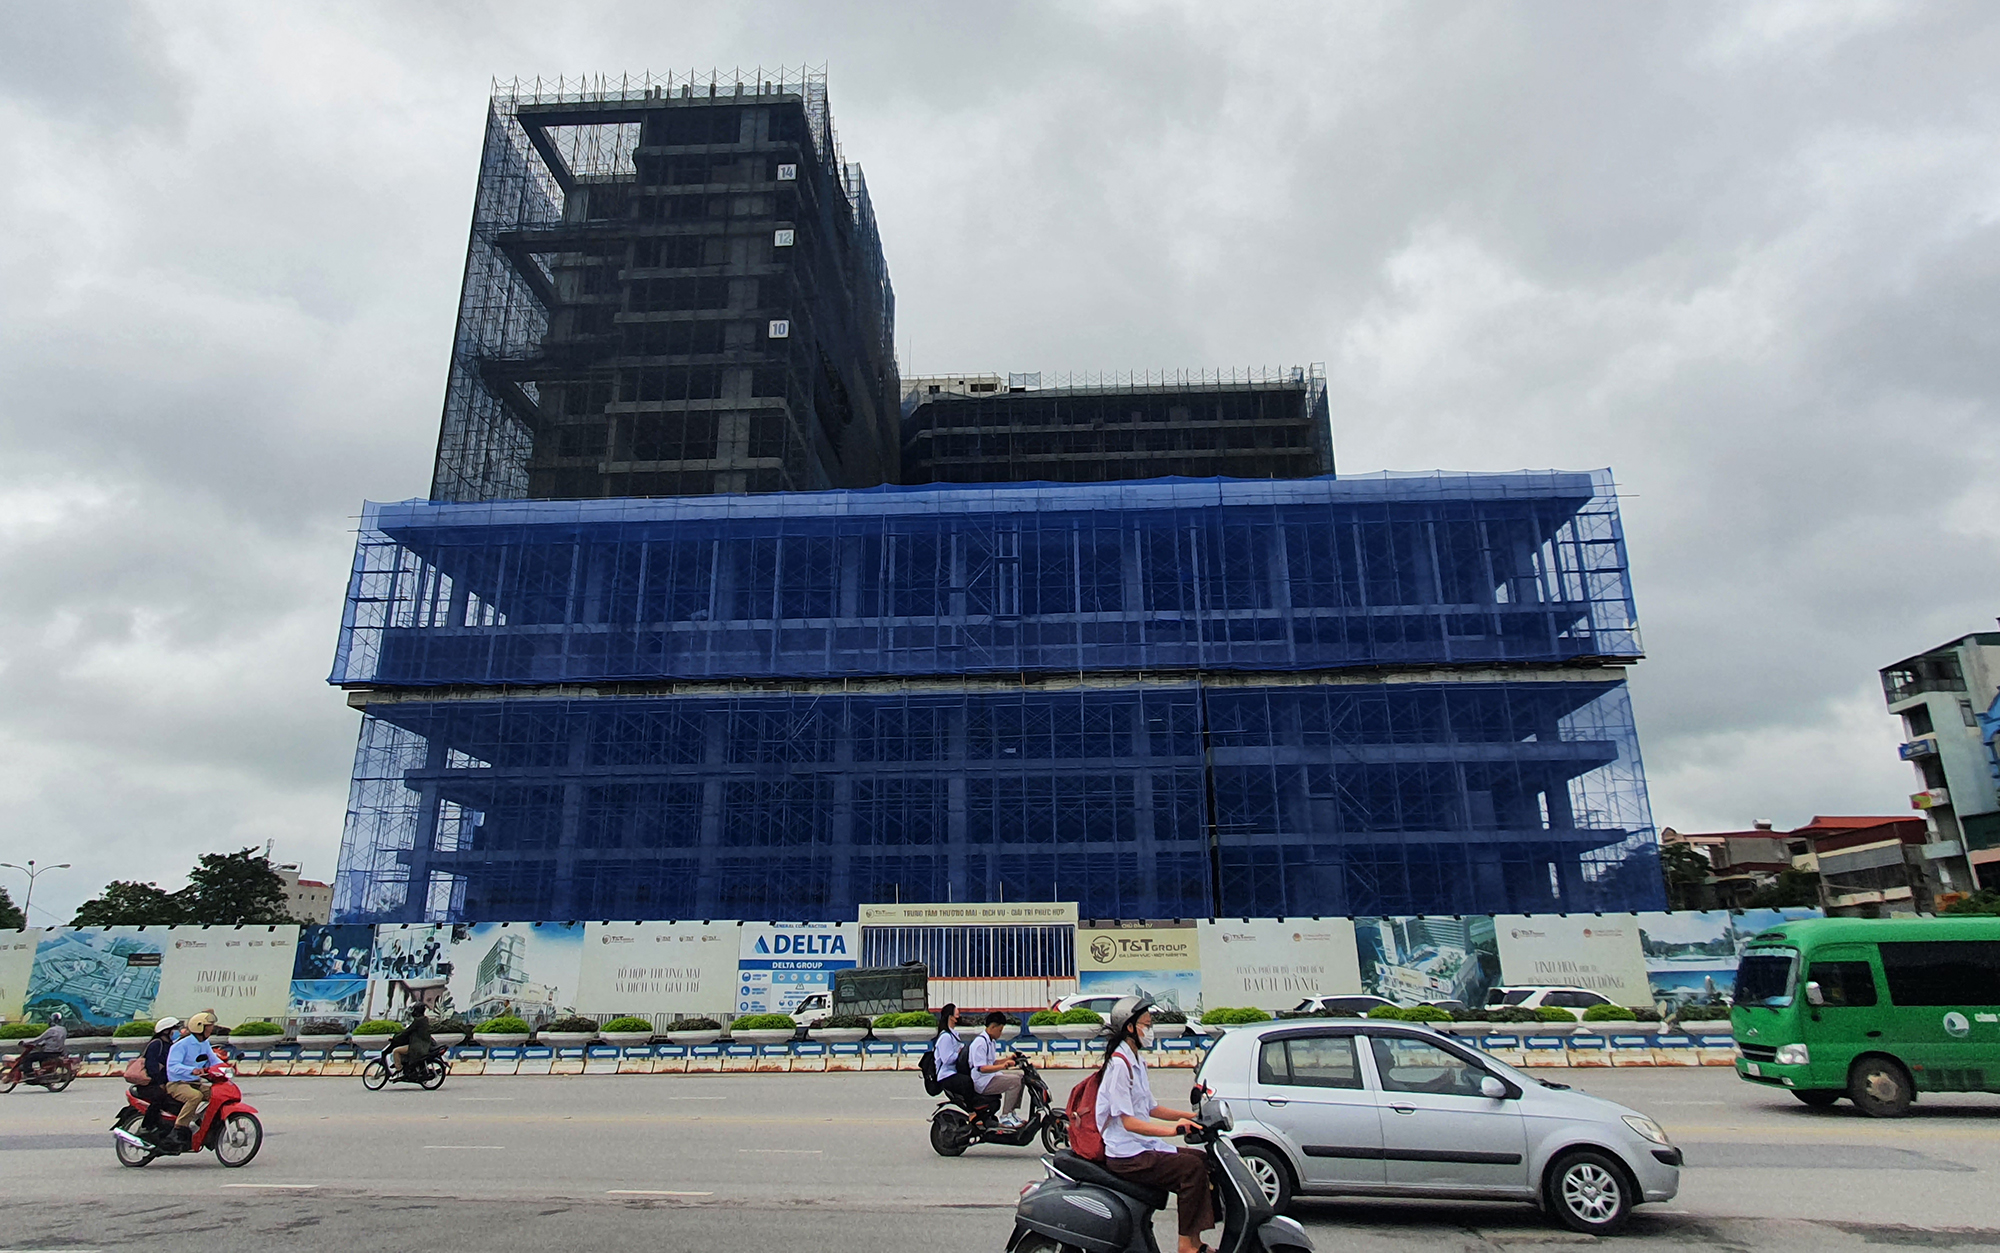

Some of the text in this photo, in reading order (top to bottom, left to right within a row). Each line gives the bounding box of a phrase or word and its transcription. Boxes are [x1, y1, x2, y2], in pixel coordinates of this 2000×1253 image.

[781, 166, 794, 178] 14
[778, 232, 791, 244] 12
[772, 323, 786, 335] 10
[903, 909, 923, 917] TRUNG
[925, 908, 938, 917] TÂM
[774, 935, 847, 954] DELTA
[1118, 939, 1153, 952] T&T
